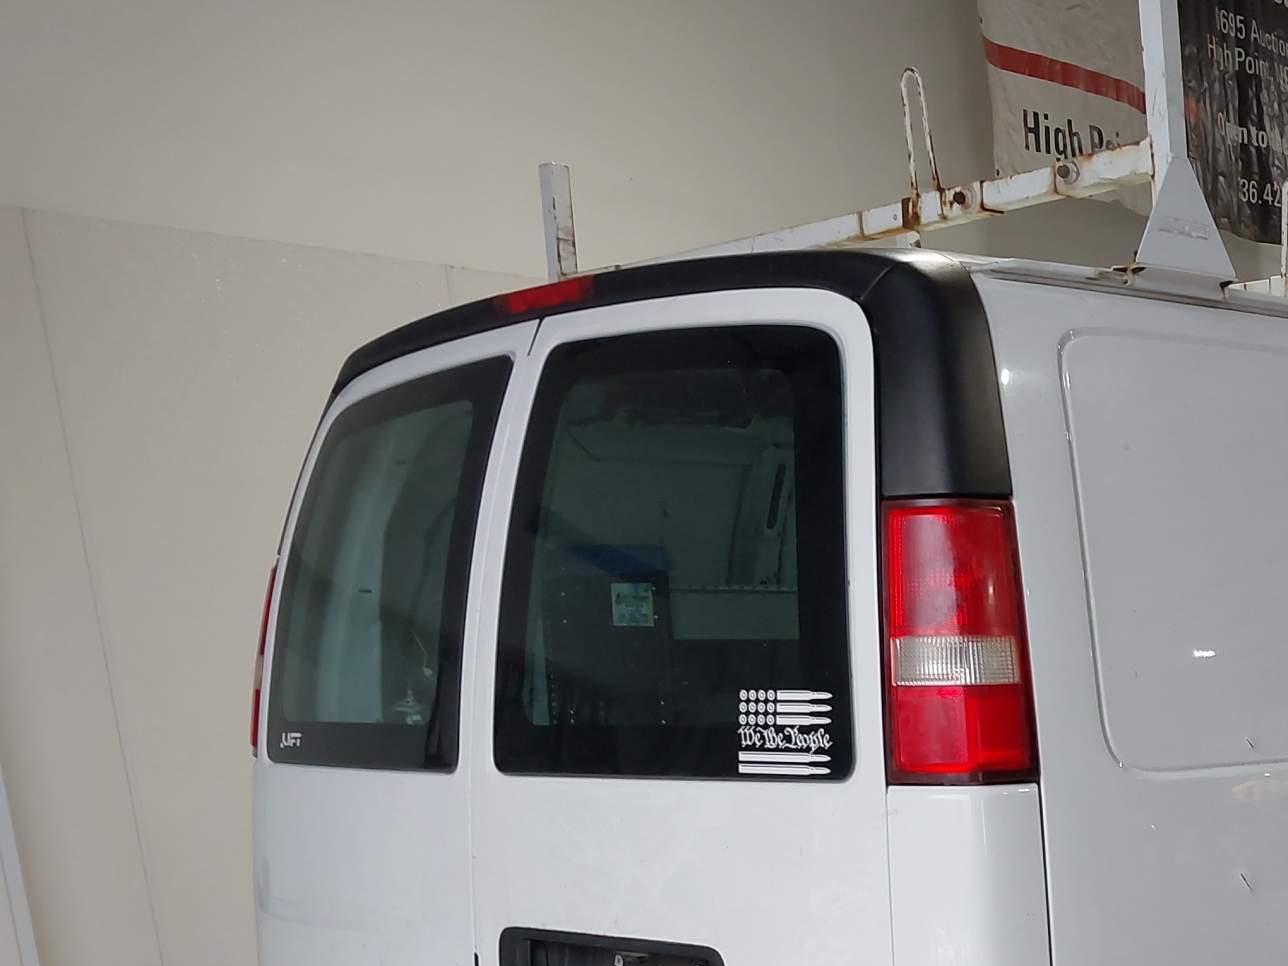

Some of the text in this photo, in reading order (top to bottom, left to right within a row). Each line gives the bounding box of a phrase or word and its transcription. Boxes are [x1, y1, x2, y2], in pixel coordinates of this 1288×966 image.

[1215, 6, 1246, 40] 1695
[1022, 108, 1084, 162] High
[737, 725, 834, 754] We The People
